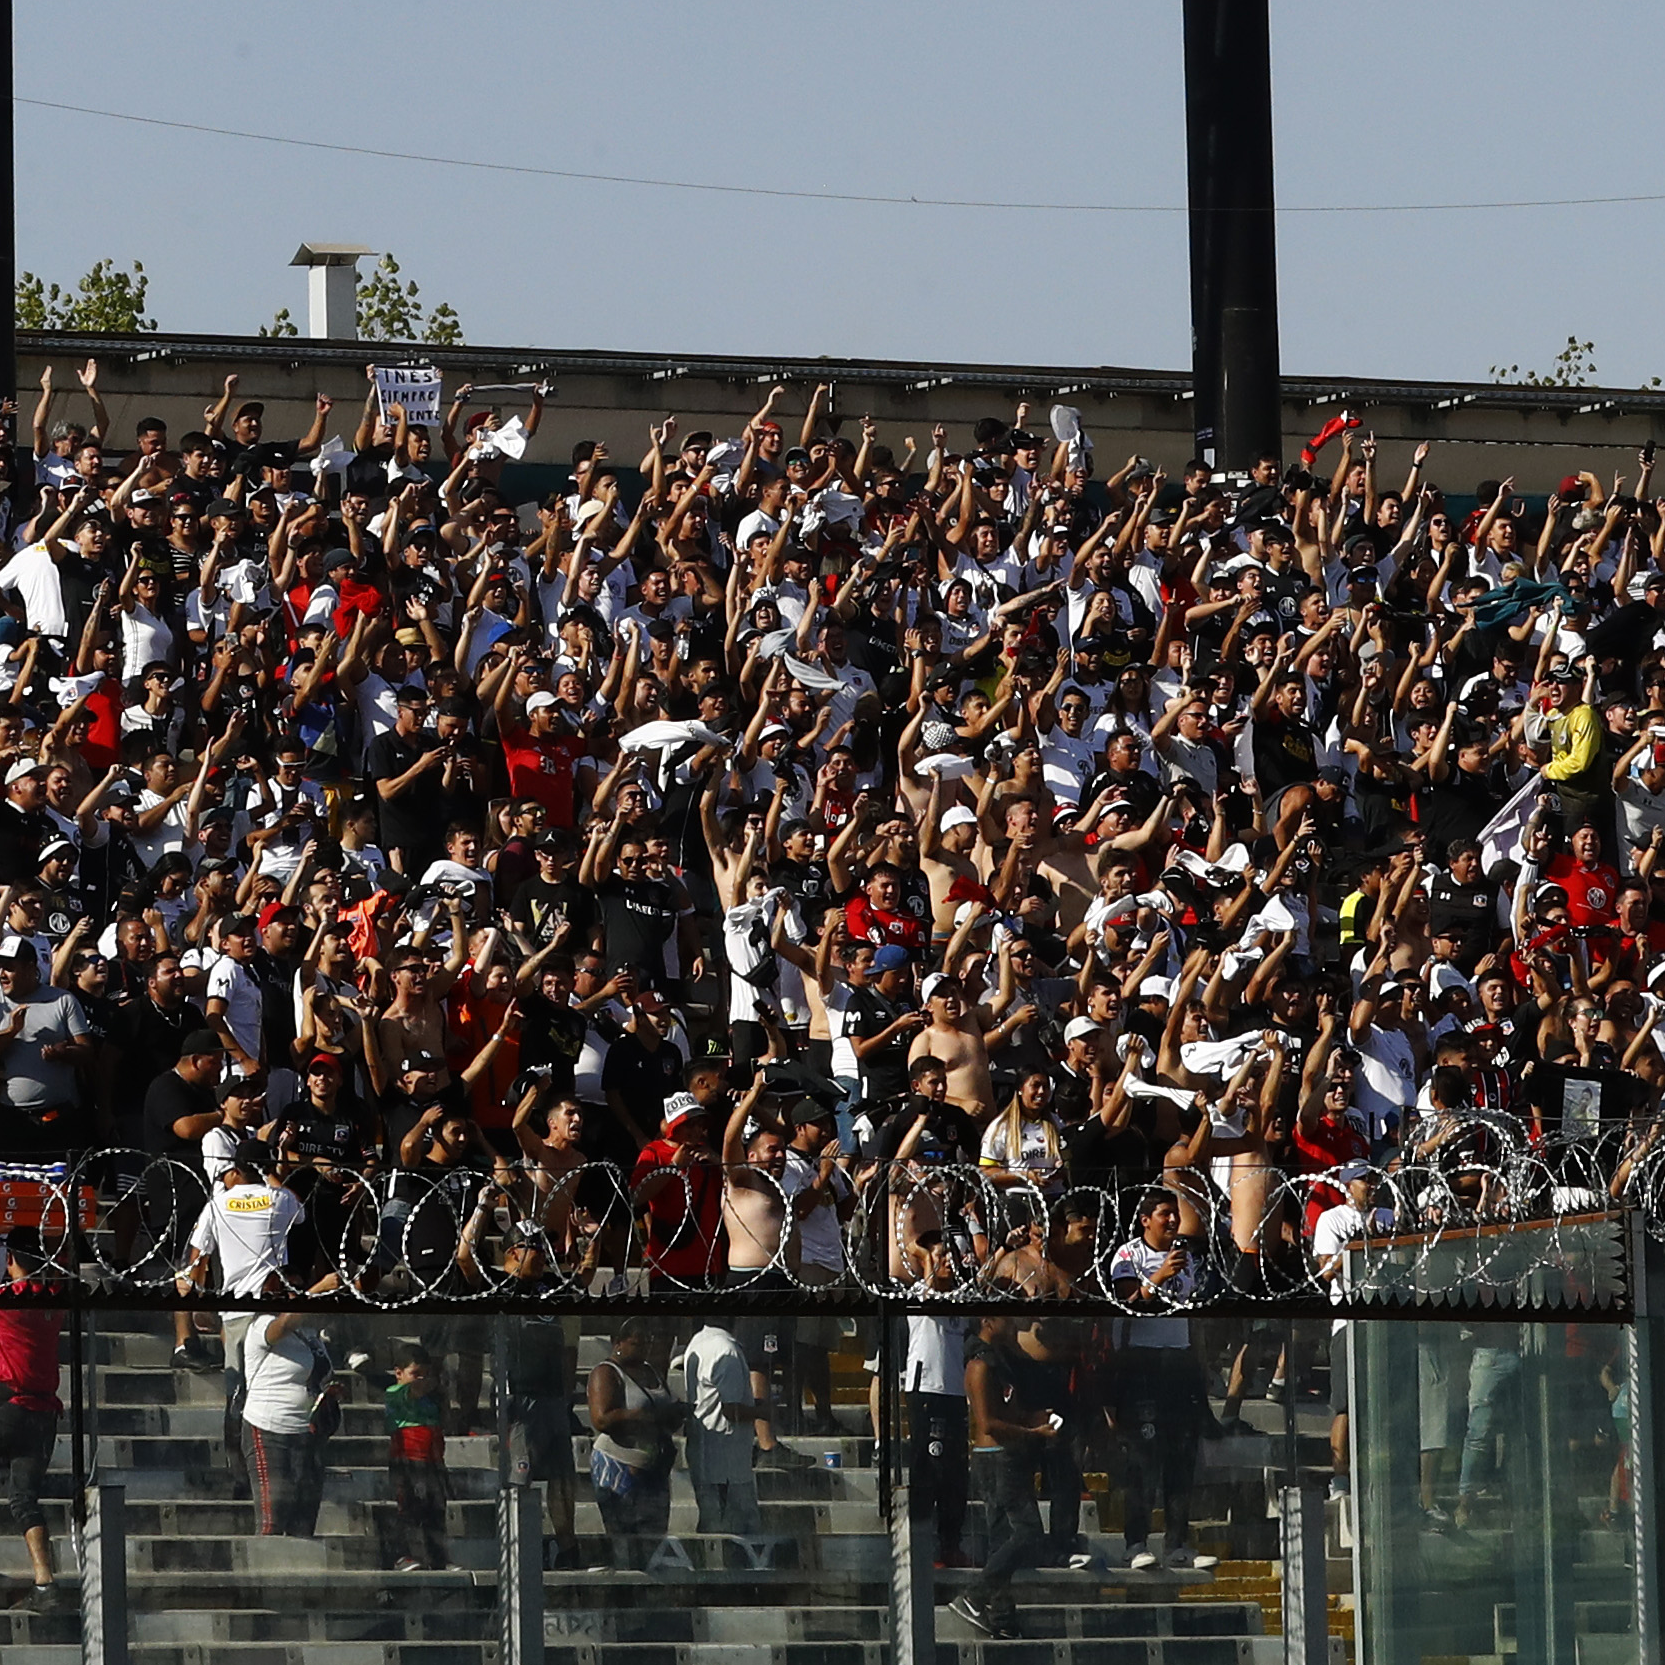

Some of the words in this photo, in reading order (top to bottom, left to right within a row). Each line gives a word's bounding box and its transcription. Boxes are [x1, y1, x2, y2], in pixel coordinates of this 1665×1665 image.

[385, 368, 433, 384] INES
[1278, 596, 1296, 617] MG
[1586, 886, 1607, 909] MG
[49, 911, 71, 933] MG
[1021, 1147, 1046, 1162] DIRE
[228, 1196, 270, 1212] CRISTAL
